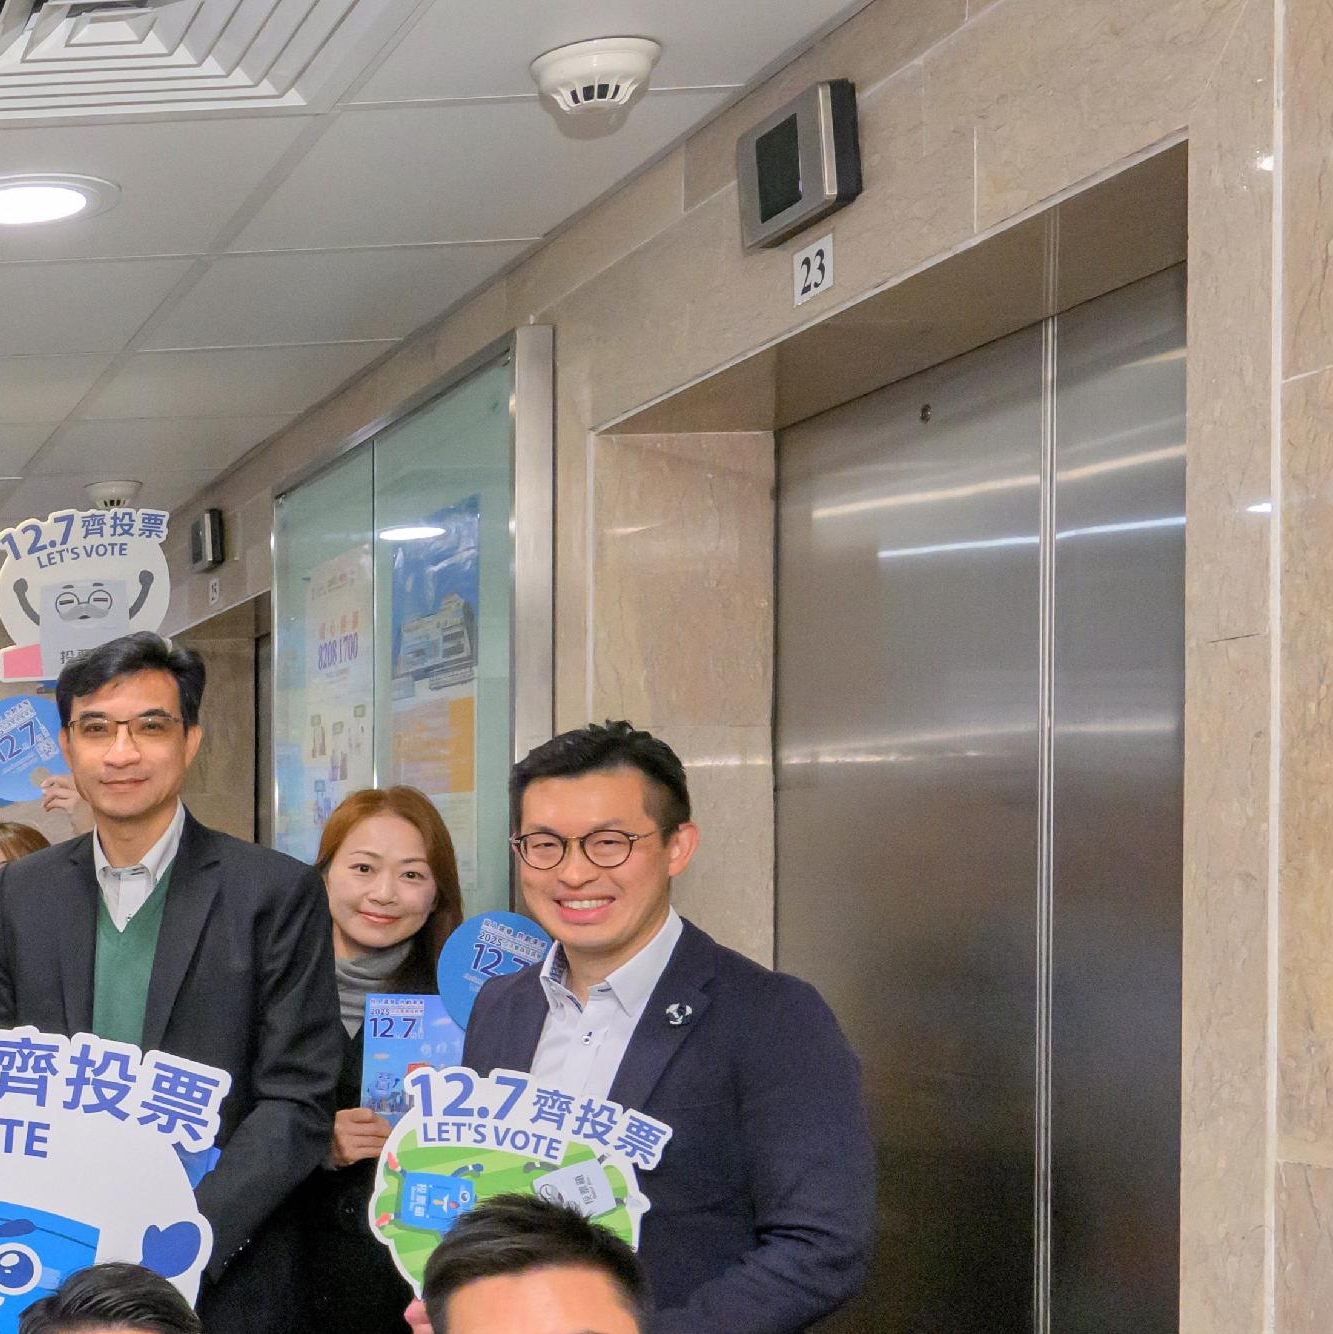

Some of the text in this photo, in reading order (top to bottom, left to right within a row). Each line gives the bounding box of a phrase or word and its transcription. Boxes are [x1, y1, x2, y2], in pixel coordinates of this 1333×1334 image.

[800, 248, 826, 296] 23
[0, 512, 166, 562] 12.7 齊投票
[36, 542, 128, 569] LET'S VOTE
[410, 1072, 667, 1165] 12.7 齊投票
[422, 1121, 563, 1161] LET'S VOTE
